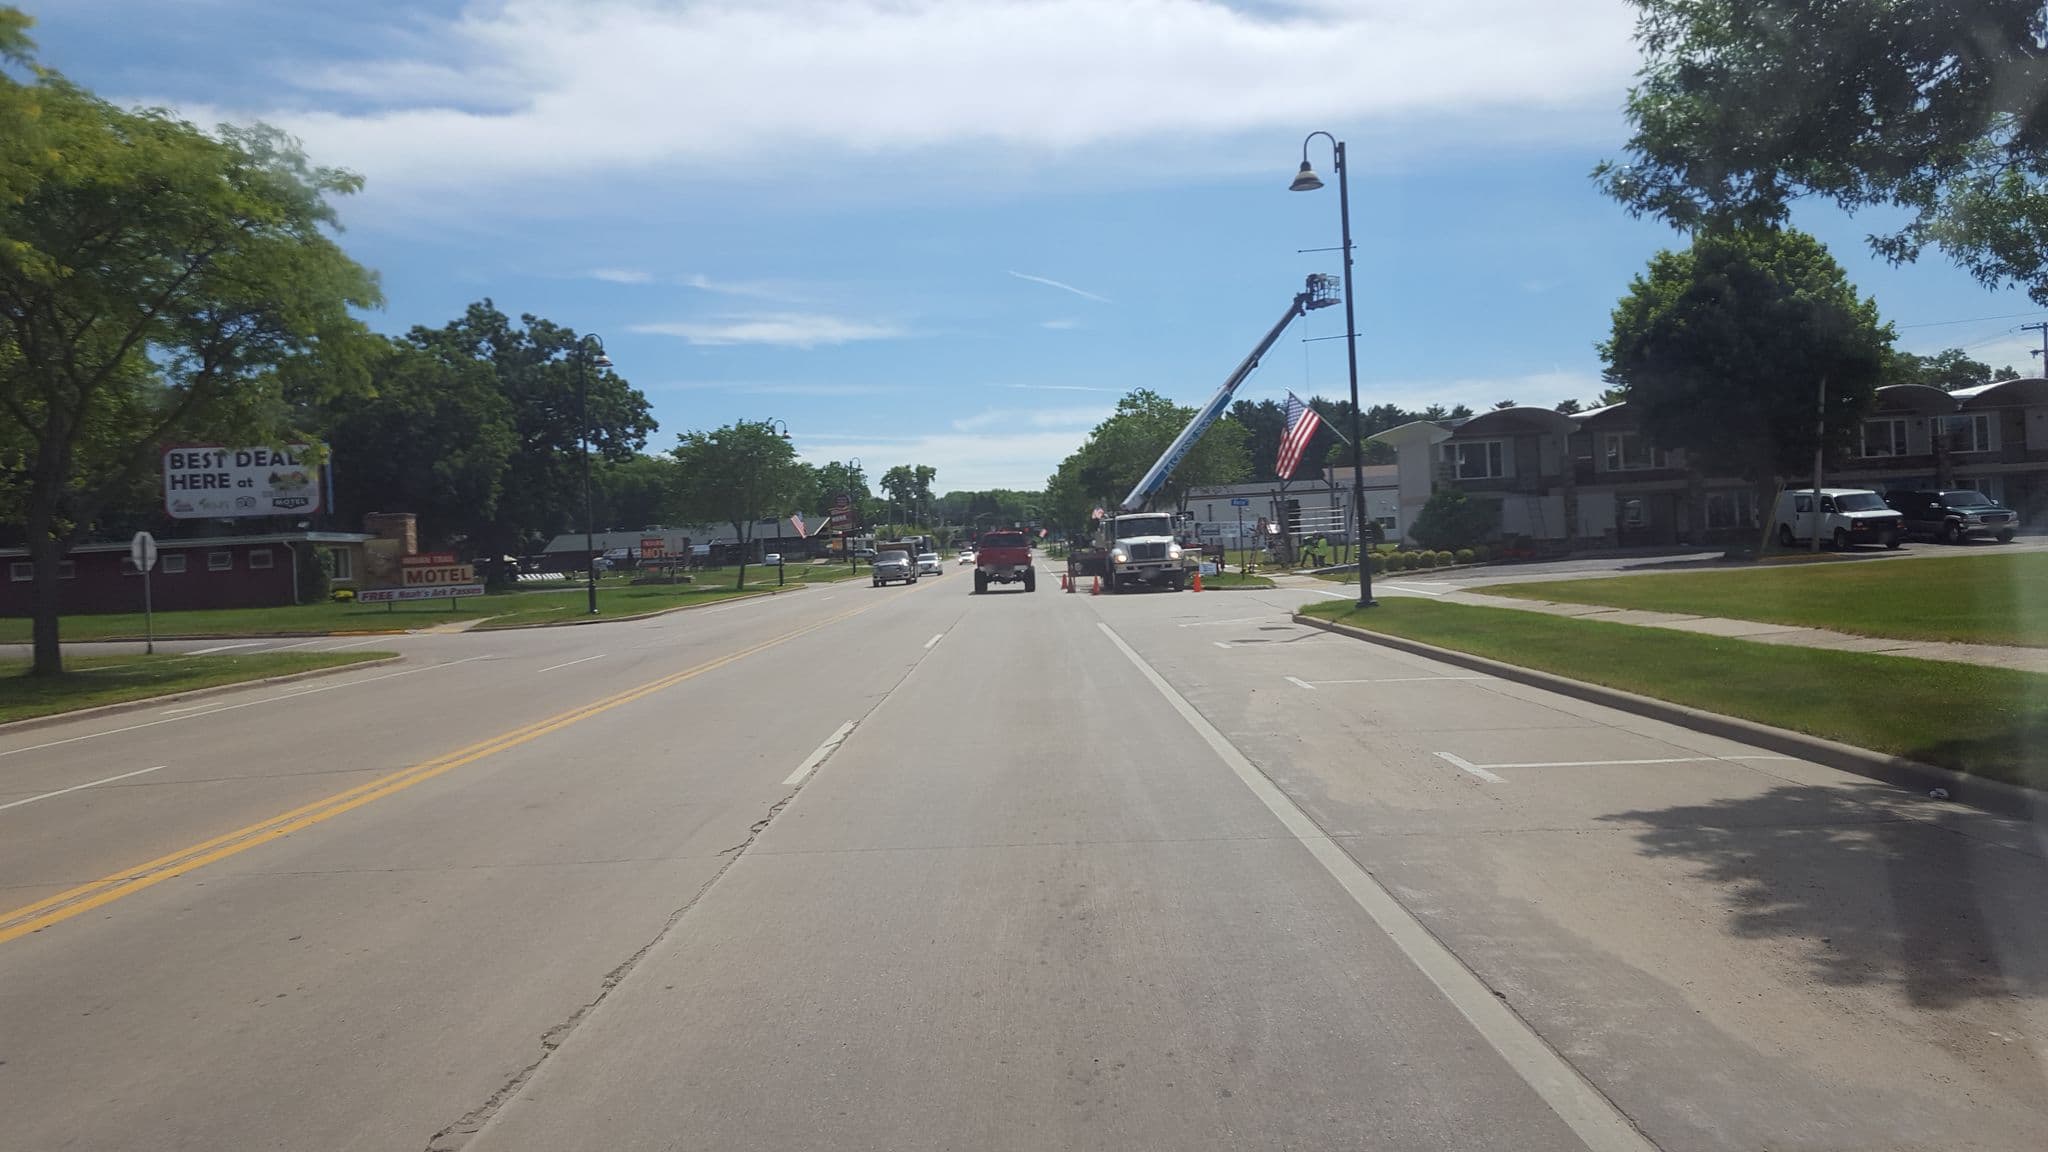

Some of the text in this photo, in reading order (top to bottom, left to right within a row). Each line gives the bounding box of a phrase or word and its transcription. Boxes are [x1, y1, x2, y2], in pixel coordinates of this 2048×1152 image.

[170, 450, 305, 470] BEST DEAL
[170, 473, 254, 490] HERE at
[407, 569, 472, 584] MOTEL
[362, 592, 393, 601] FREE
